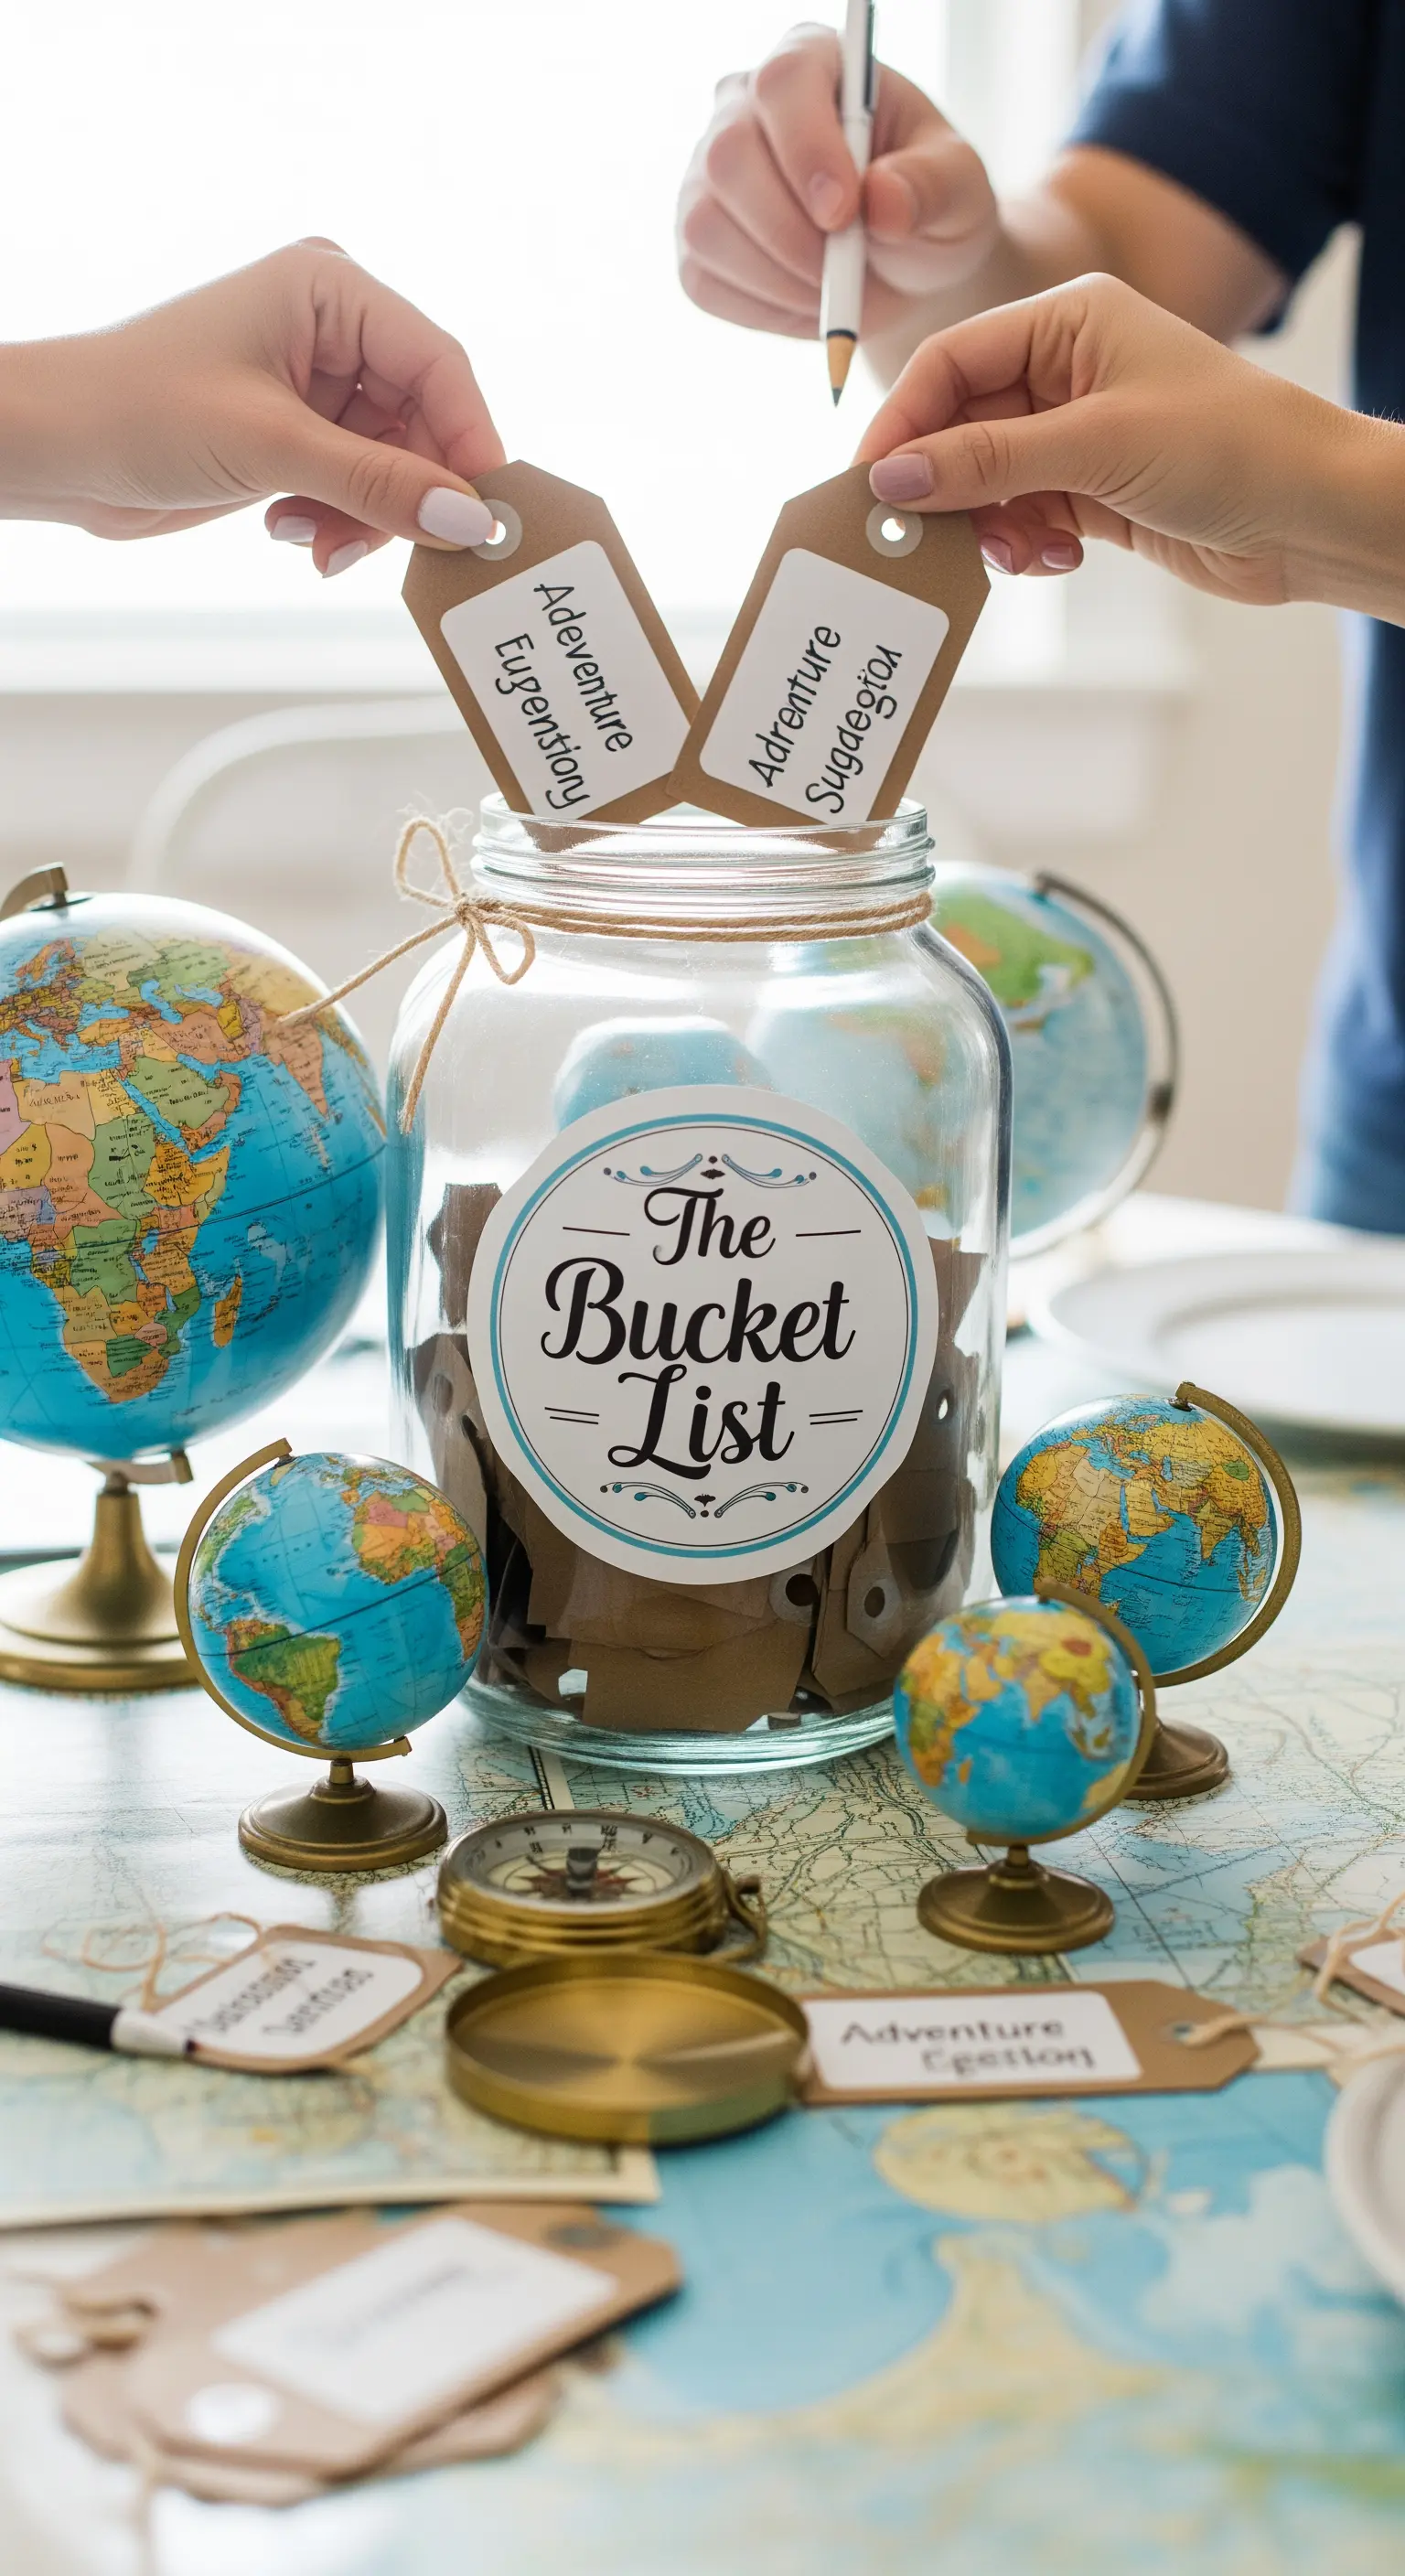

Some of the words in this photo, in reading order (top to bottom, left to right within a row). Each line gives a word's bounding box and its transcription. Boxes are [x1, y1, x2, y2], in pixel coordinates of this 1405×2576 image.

[643, 1186, 777, 1266] The
[540, 1256, 857, 1366] Bucket
[606, 1362, 796, 1481] List
[839, 2019, 1065, 2046] Adventure
